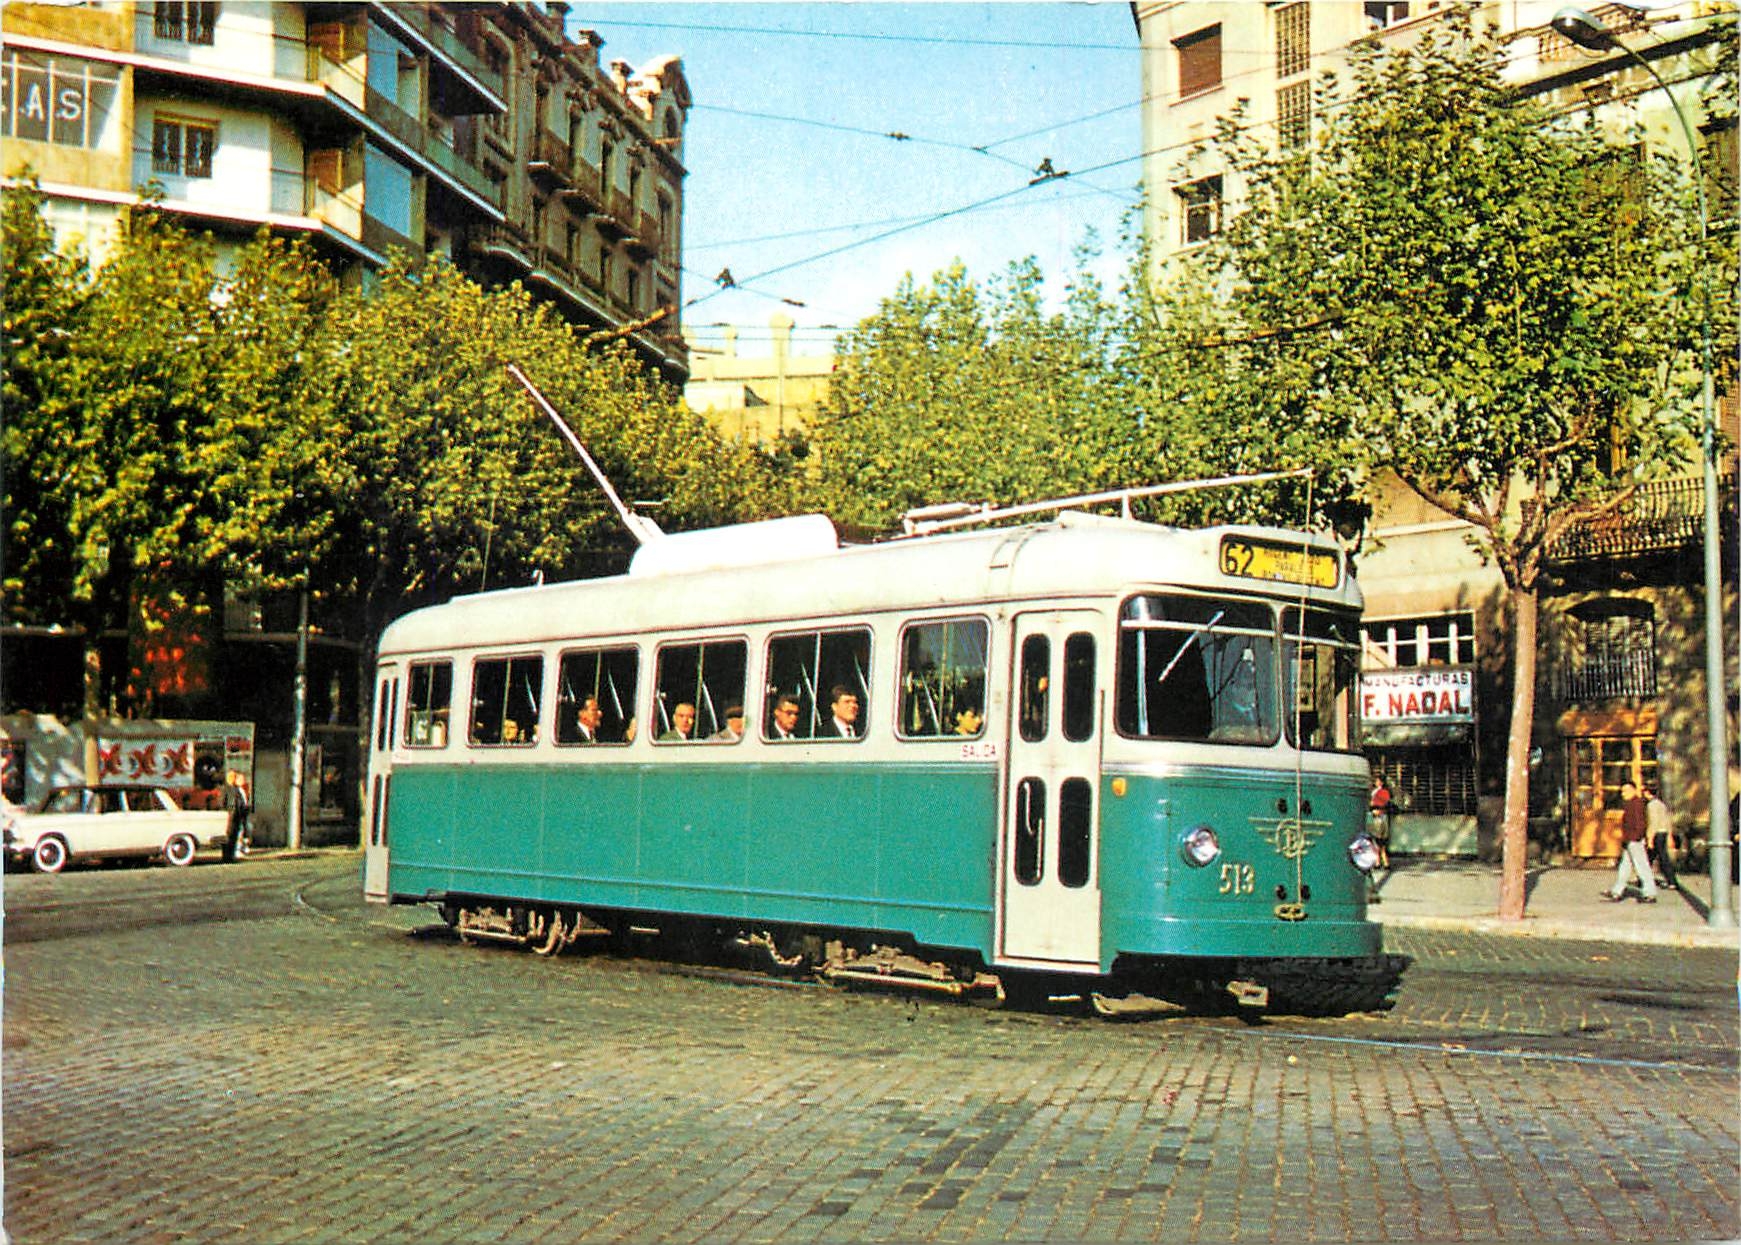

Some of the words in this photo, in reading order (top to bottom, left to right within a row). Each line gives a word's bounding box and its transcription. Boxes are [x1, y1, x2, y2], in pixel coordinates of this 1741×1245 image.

[1225, 541, 1254, 576] 62
[1363, 672, 1469, 687] MANUFACTURAS
[1363, 693, 1380, 717] F.
[1388, 690, 1470, 717] NADAL
[962, 744, 996, 758] SADA
[1219, 863, 1256, 895] 513
